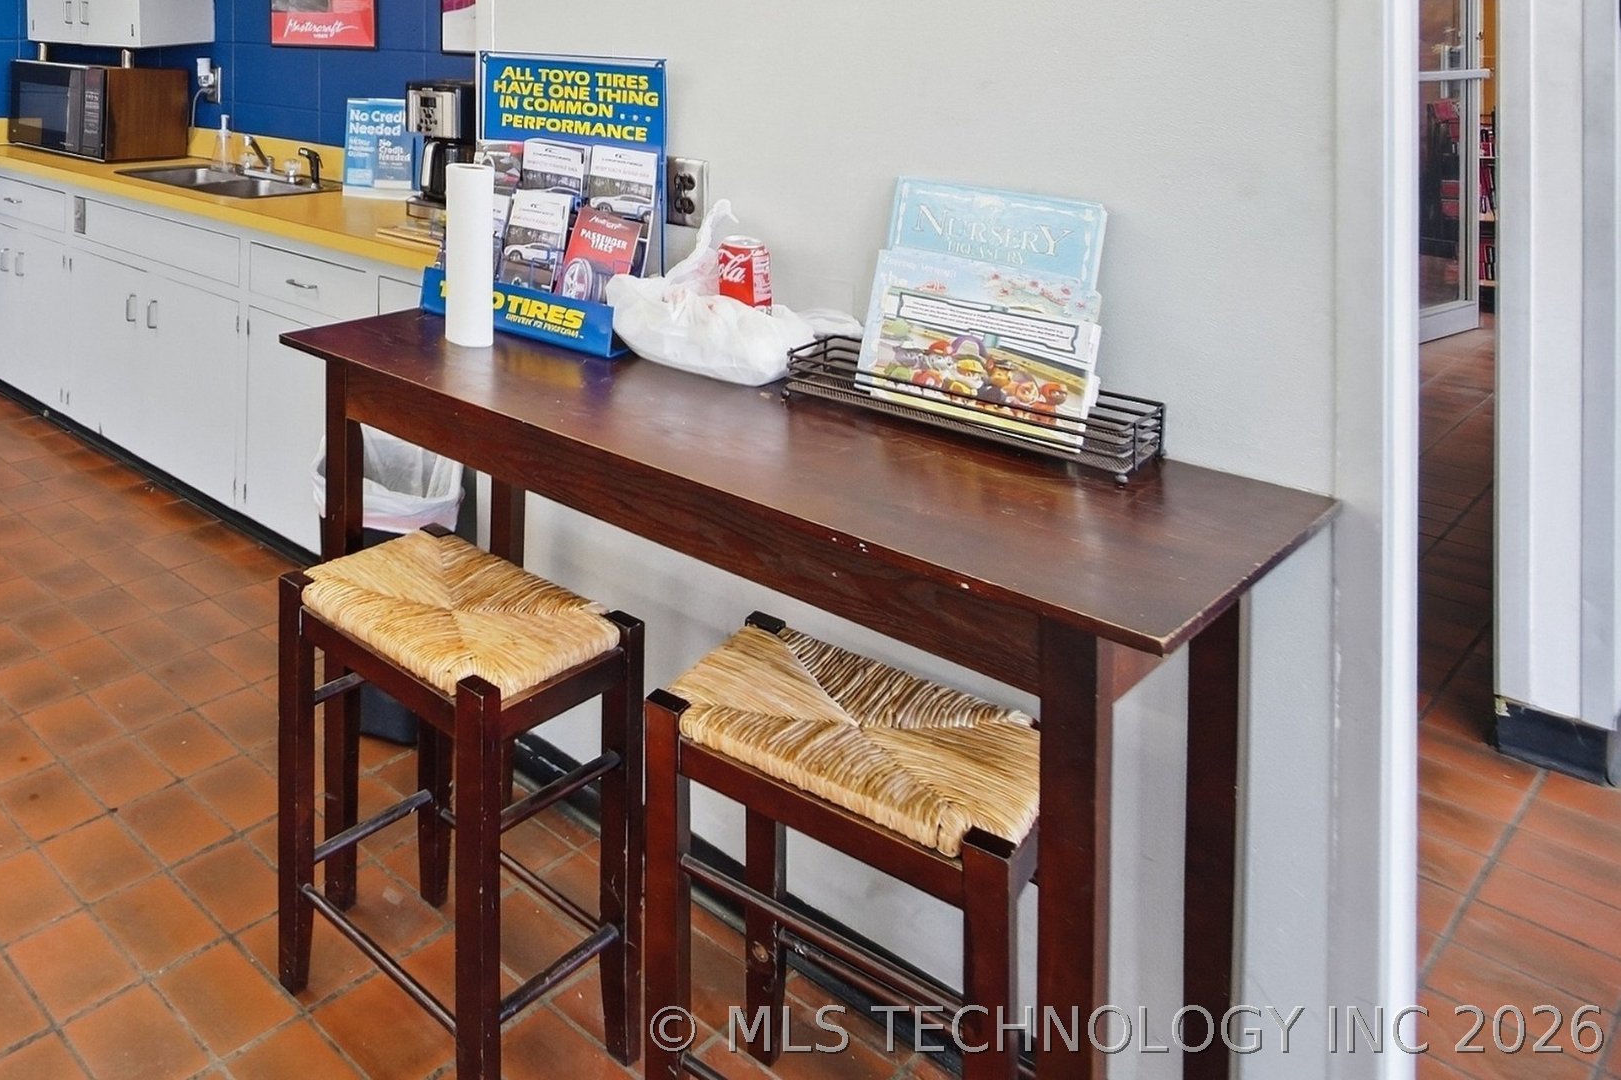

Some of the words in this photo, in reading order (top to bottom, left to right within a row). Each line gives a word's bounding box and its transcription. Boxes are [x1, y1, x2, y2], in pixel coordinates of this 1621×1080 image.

[501, 66, 534, 81] ALL
[538, 68, 590, 86] TOYO
[595, 72, 649, 90] TIRES
[493, 80, 544, 97] HAVE
[548, 84, 590, 102] ONE
[595, 87, 659, 107] THING
[350, 109, 369, 121] No
[371, 110, 405, 123] Cred
[499, 95, 518, 109] IN
[523, 97, 613, 119] COMMON
[349, 122, 401, 136] Needed
[501, 113, 648, 142] PERFORMANCE
[911, 203, 1075, 256] NURSERY
[507, 295, 586, 330] TIRES
